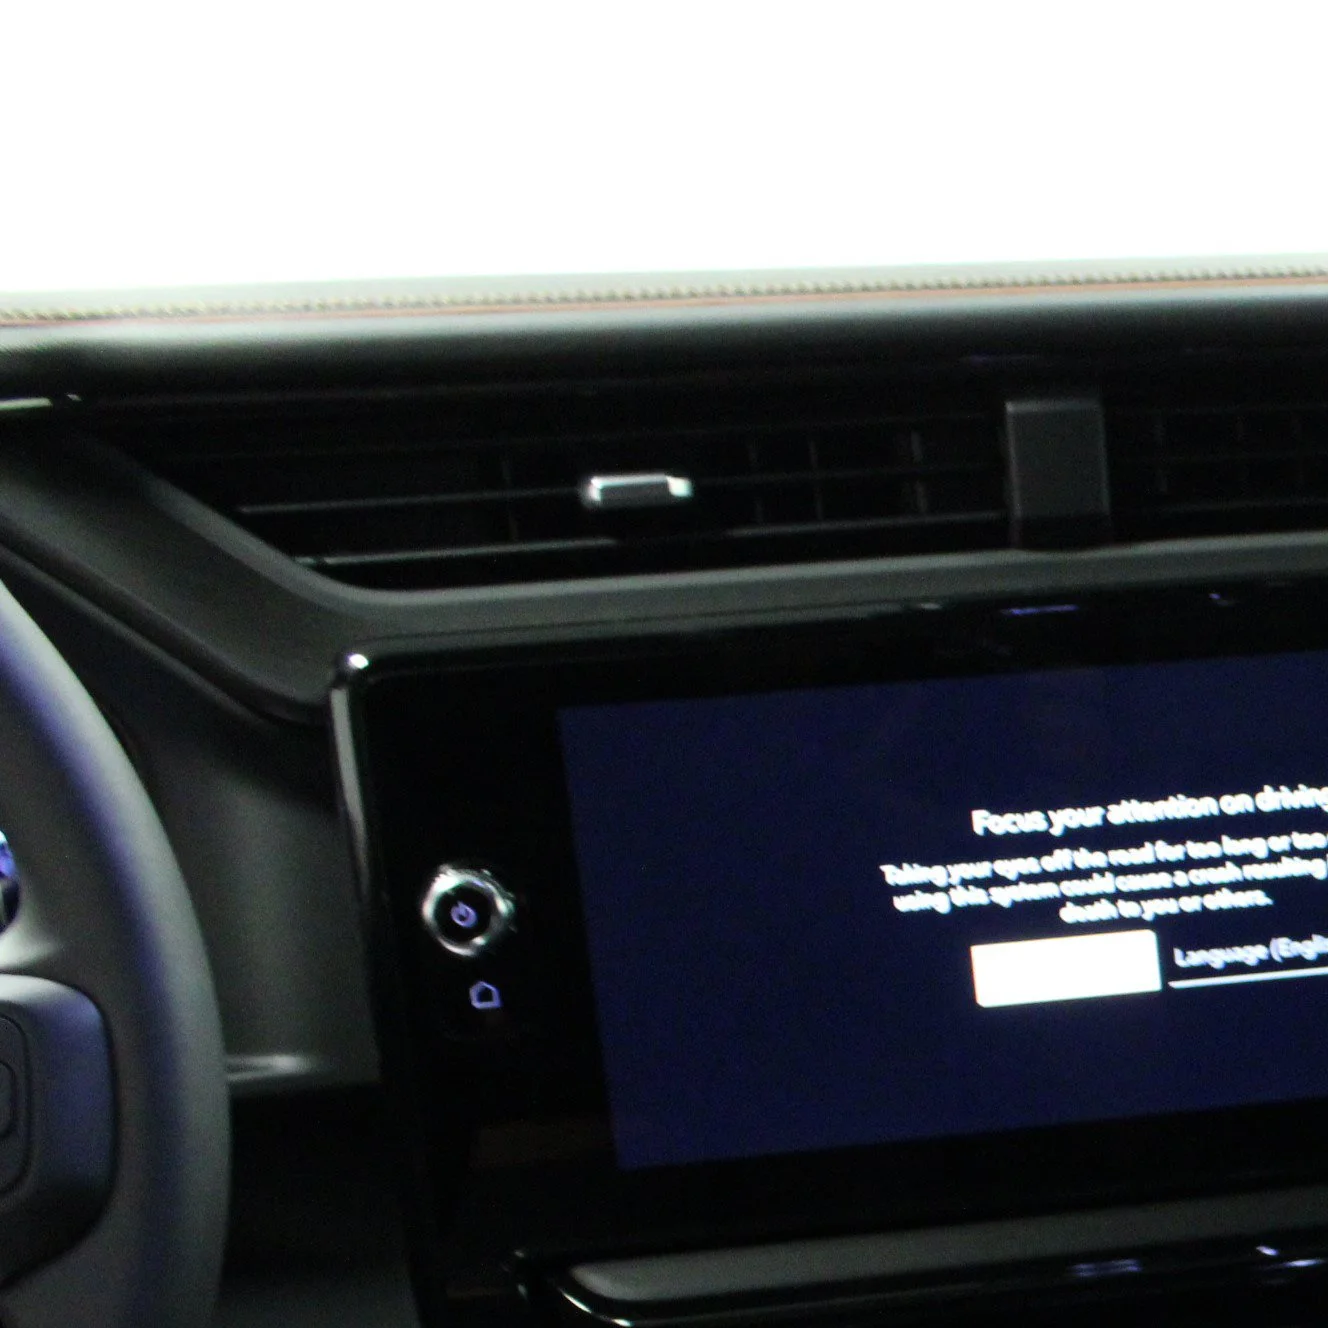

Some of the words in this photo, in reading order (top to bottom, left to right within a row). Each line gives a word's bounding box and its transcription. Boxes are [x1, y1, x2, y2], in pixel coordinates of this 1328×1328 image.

[971, 809, 1048, 836] Focus
[1048, 806, 1106, 837] your
[1107, 794, 1219, 825] attention
[1219, 793, 1255, 815] on
[880, 863, 949, 887] Taking
[947, 861, 993, 885] your
[993, 856, 1042, 881] eyes
[1040, 848, 1073, 872] off
[1073, 847, 1108, 869] the
[1108, 841, 1155, 866] road
[1155, 840, 1185, 862] for
[1185, 840, 1222, 860] too
[1221, 834, 1268, 859] long
[1268, 836, 1291, 852] or
[893, 890, 950, 914] using
[949, 885, 990, 907] this
[988, 881, 1061, 908] system
[1059, 871, 1116, 897] could
[1188, 861, 1243, 885] crash
[1243, 856, 1328, 880] resulting
[1059, 899, 1118, 924] death
[1117, 899, 1141, 918] to
[1140, 898, 1179, 921] you
[1178, 895, 1202, 913] or
[1173, 943, 1269, 969] Language
